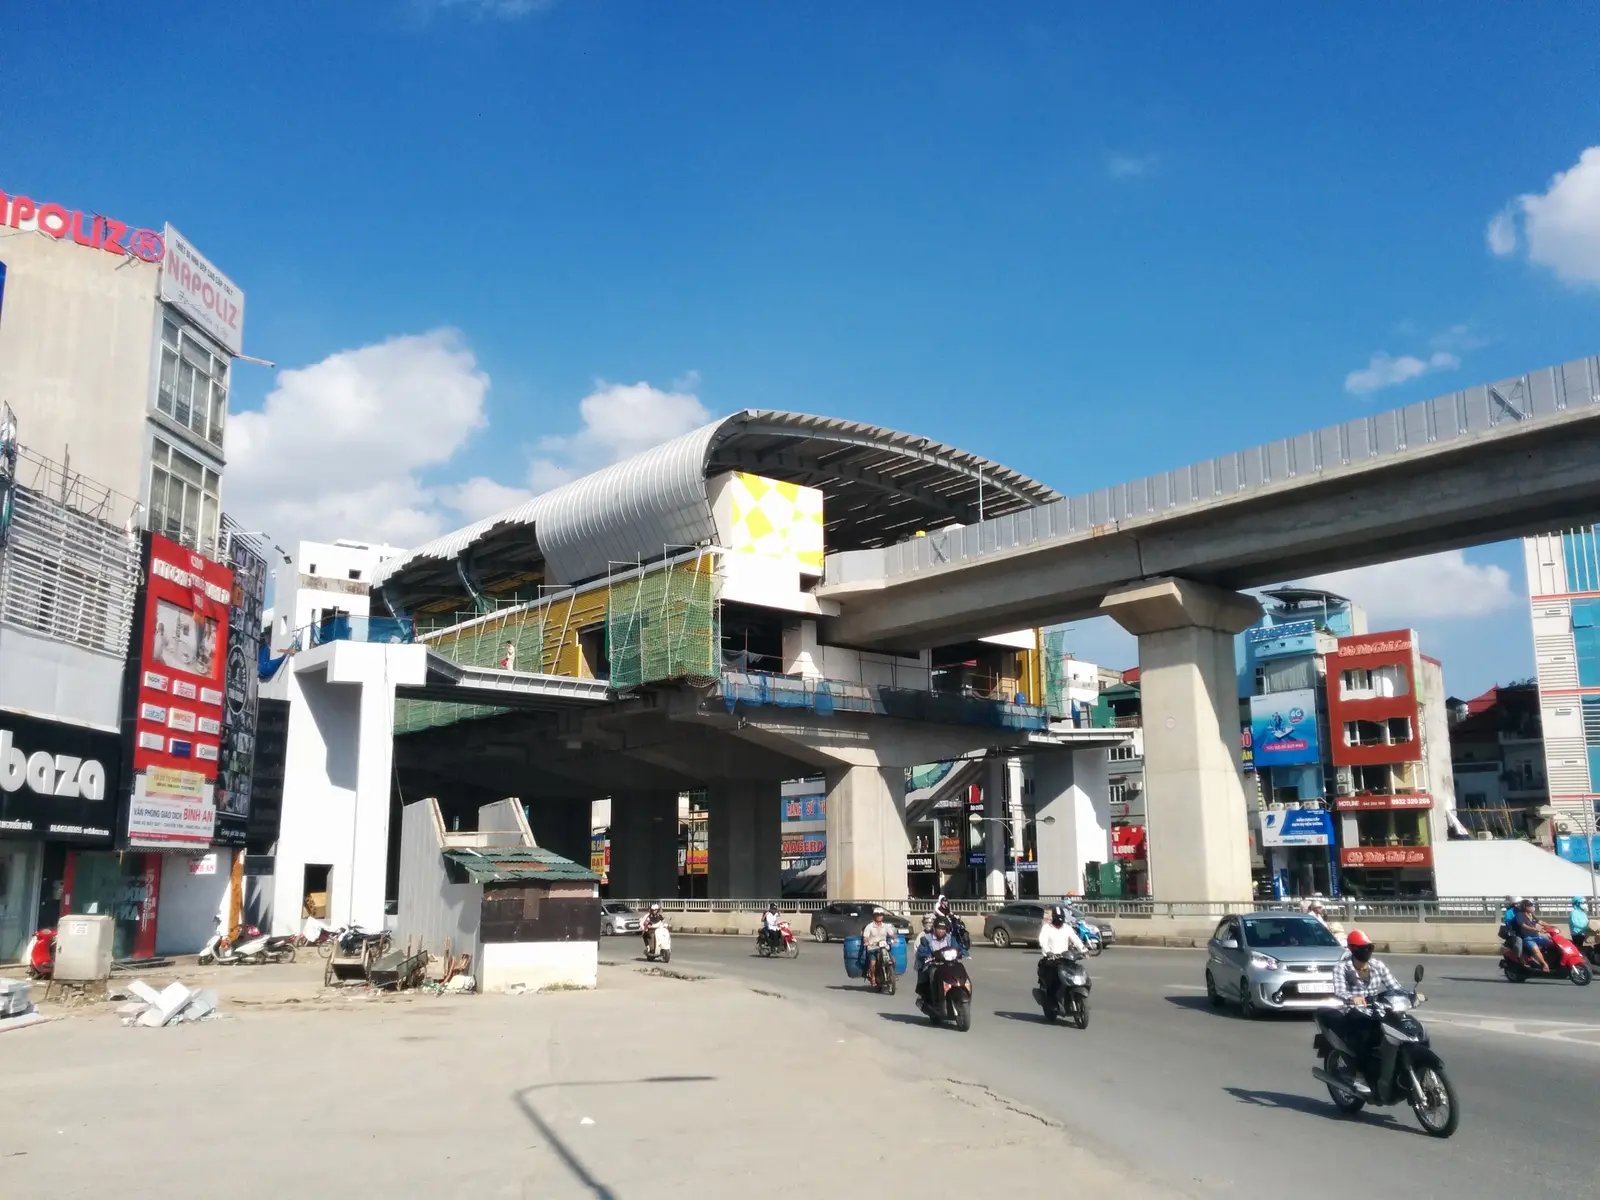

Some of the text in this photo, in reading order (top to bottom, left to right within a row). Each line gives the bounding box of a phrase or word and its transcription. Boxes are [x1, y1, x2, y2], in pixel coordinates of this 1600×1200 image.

[0, 189, 127, 255] POLIZ
[168, 249, 237, 330] NAPOLIZ
[1290, 709, 1302, 717] 4G
[202, 809, 213, 823] AN
